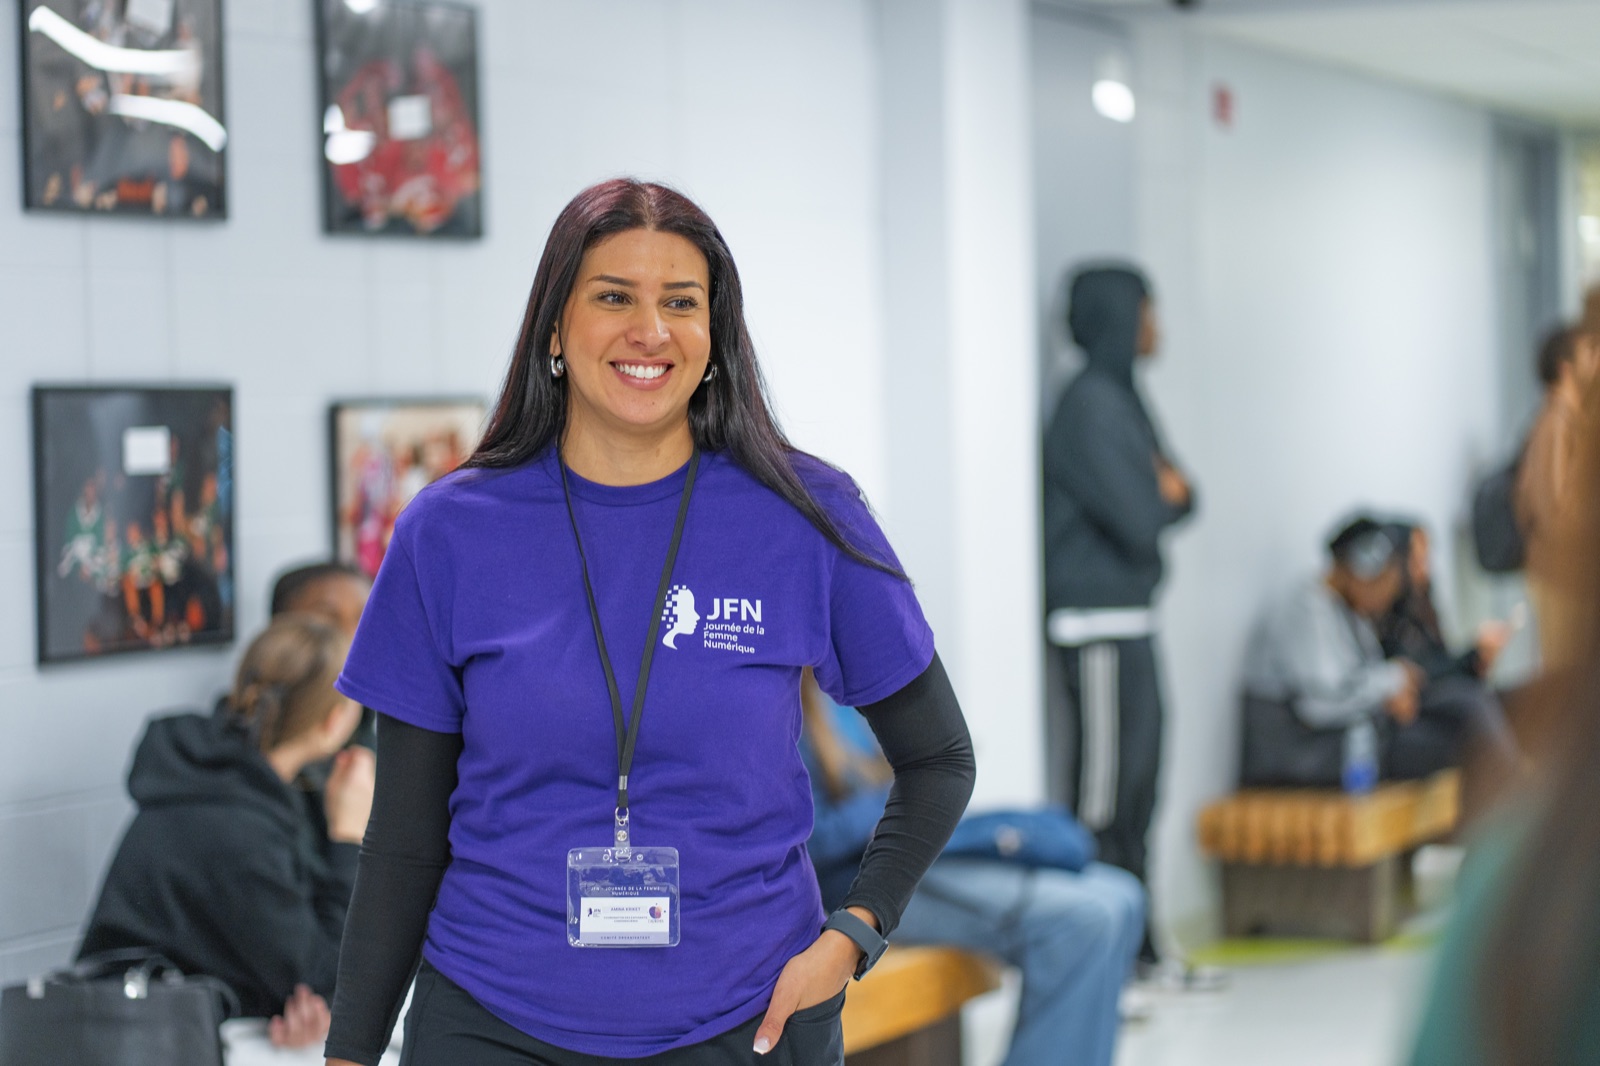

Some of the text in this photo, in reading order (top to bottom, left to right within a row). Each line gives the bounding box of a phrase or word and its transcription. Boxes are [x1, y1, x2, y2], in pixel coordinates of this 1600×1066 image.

[706, 598, 762, 623] JFN
[703, 622, 765, 635] Journée de la
[703, 630, 738, 642] Femme
[703, 639, 755, 654] Numérique
